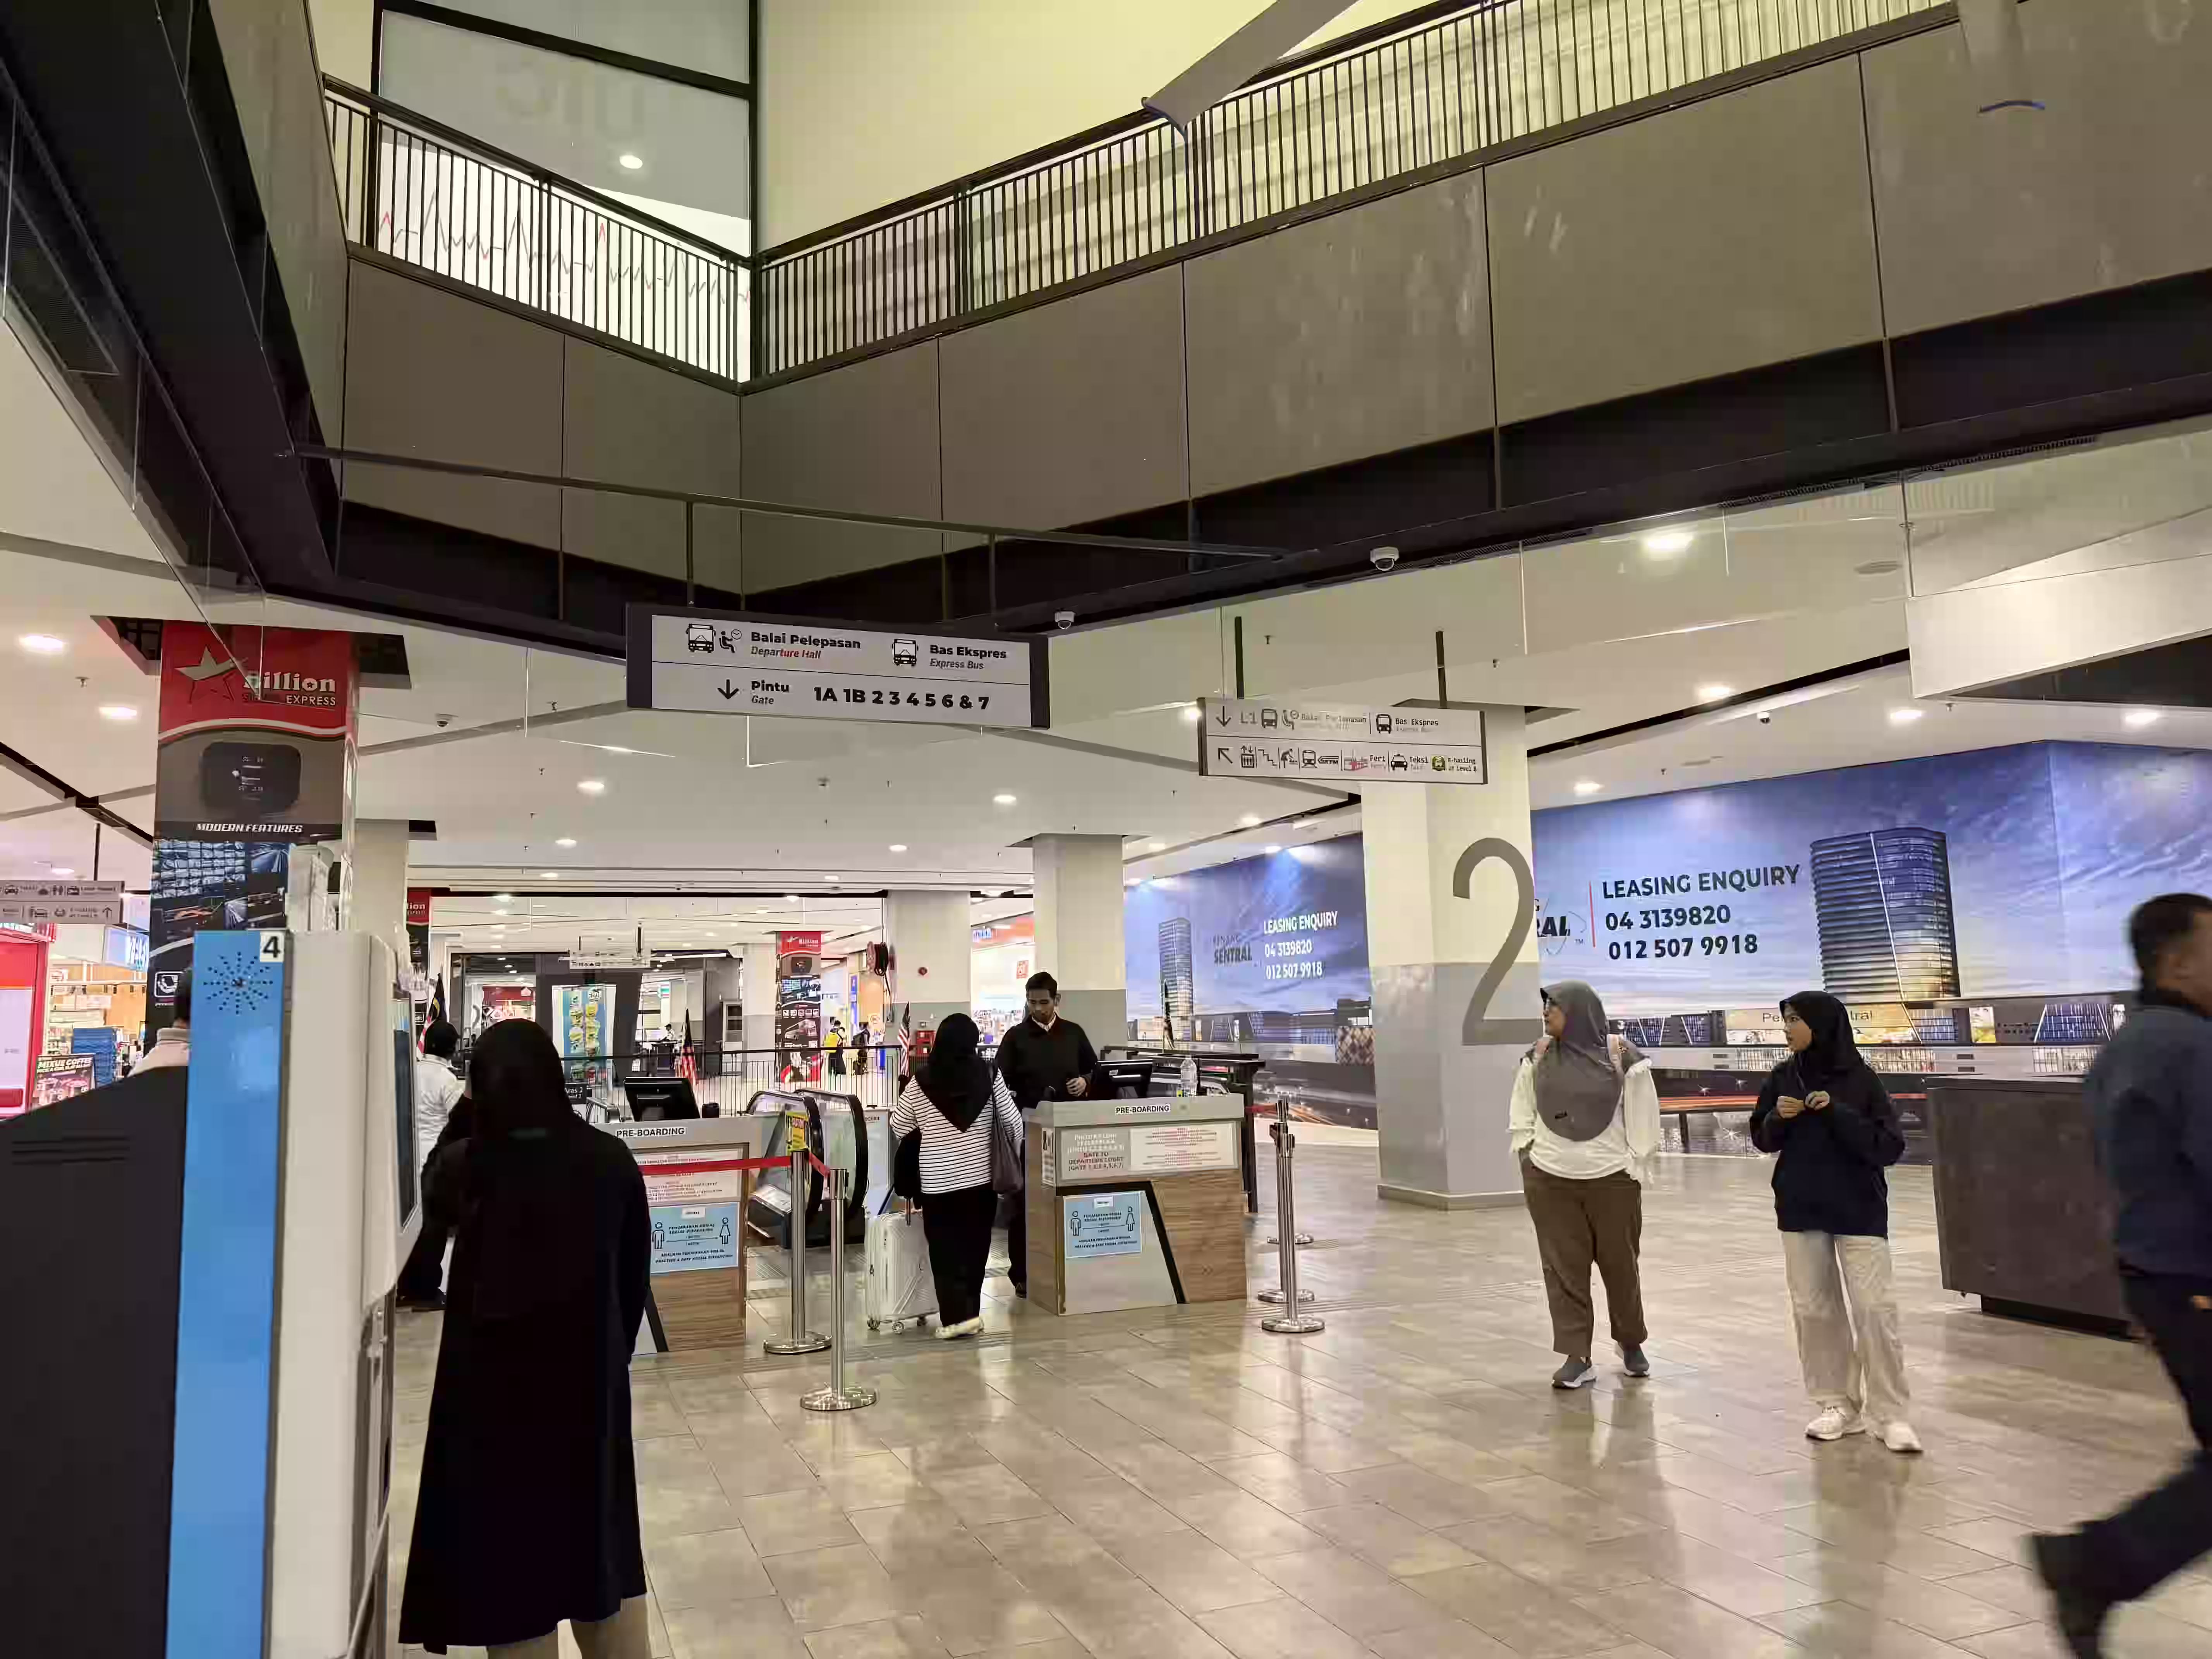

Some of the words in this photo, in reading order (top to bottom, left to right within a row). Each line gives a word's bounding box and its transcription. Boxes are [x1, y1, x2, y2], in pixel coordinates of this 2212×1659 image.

[751, 632, 786, 644] Balai
[790, 635, 862, 648] Pelepasan
[751, 646, 799, 657] Departure
[802, 649, 821, 659] Hall
[930, 645, 953, 654] Bas
[957, 646, 1007, 659] Ekspres
[930, 658, 965, 669] Express
[967, 661, 985, 670] Bus
[751, 680, 790, 692] Pintu
[287, 695, 336, 706] EXPRESS
[751, 695, 774, 704] Gate
[814, 687, 838, 702] 1A
[843, 689, 866, 703] 1B
[872, 690, 883, 704] 2
[890, 691, 900, 705] 3
[907, 693, 919, 706] 4
[926, 693, 936, 707] 5
[942, 694, 953, 708] 6
[960, 695, 972, 709] &
[978, 696, 989, 709] 7
[1412, 718, 1438, 728] Ekspres
[196, 823, 244, 832] MODERN
[246, 824, 304, 833] FEATURES
[1602, 874, 1691, 899] LEASING
[1698, 864, 1800, 892] ENQUIRY
[1264, 916, 1297, 934] LEASING
[1299, 911, 1338, 931] ENQUIRY
[1606, 912, 1633, 930] 04
[1640, 905, 1731, 929] 3139820
[263, 936, 281, 957] 4
[1277, 938, 1312, 957] 3139820
[1453, 837, 1543, 1046] 2
[1609, 941, 1647, 959] 012
[1655, 937, 1693, 958] 507
[1701, 934, 1758, 955] 9918
[1266, 964, 1281, 979] 012
[1283, 963, 1298, 978] 507
[1300, 961, 1323, 977] 9918
[1116, 1105, 1170, 1113] PRE-BOARDING
[617, 1128, 685, 1137] PRE-BOARDING
